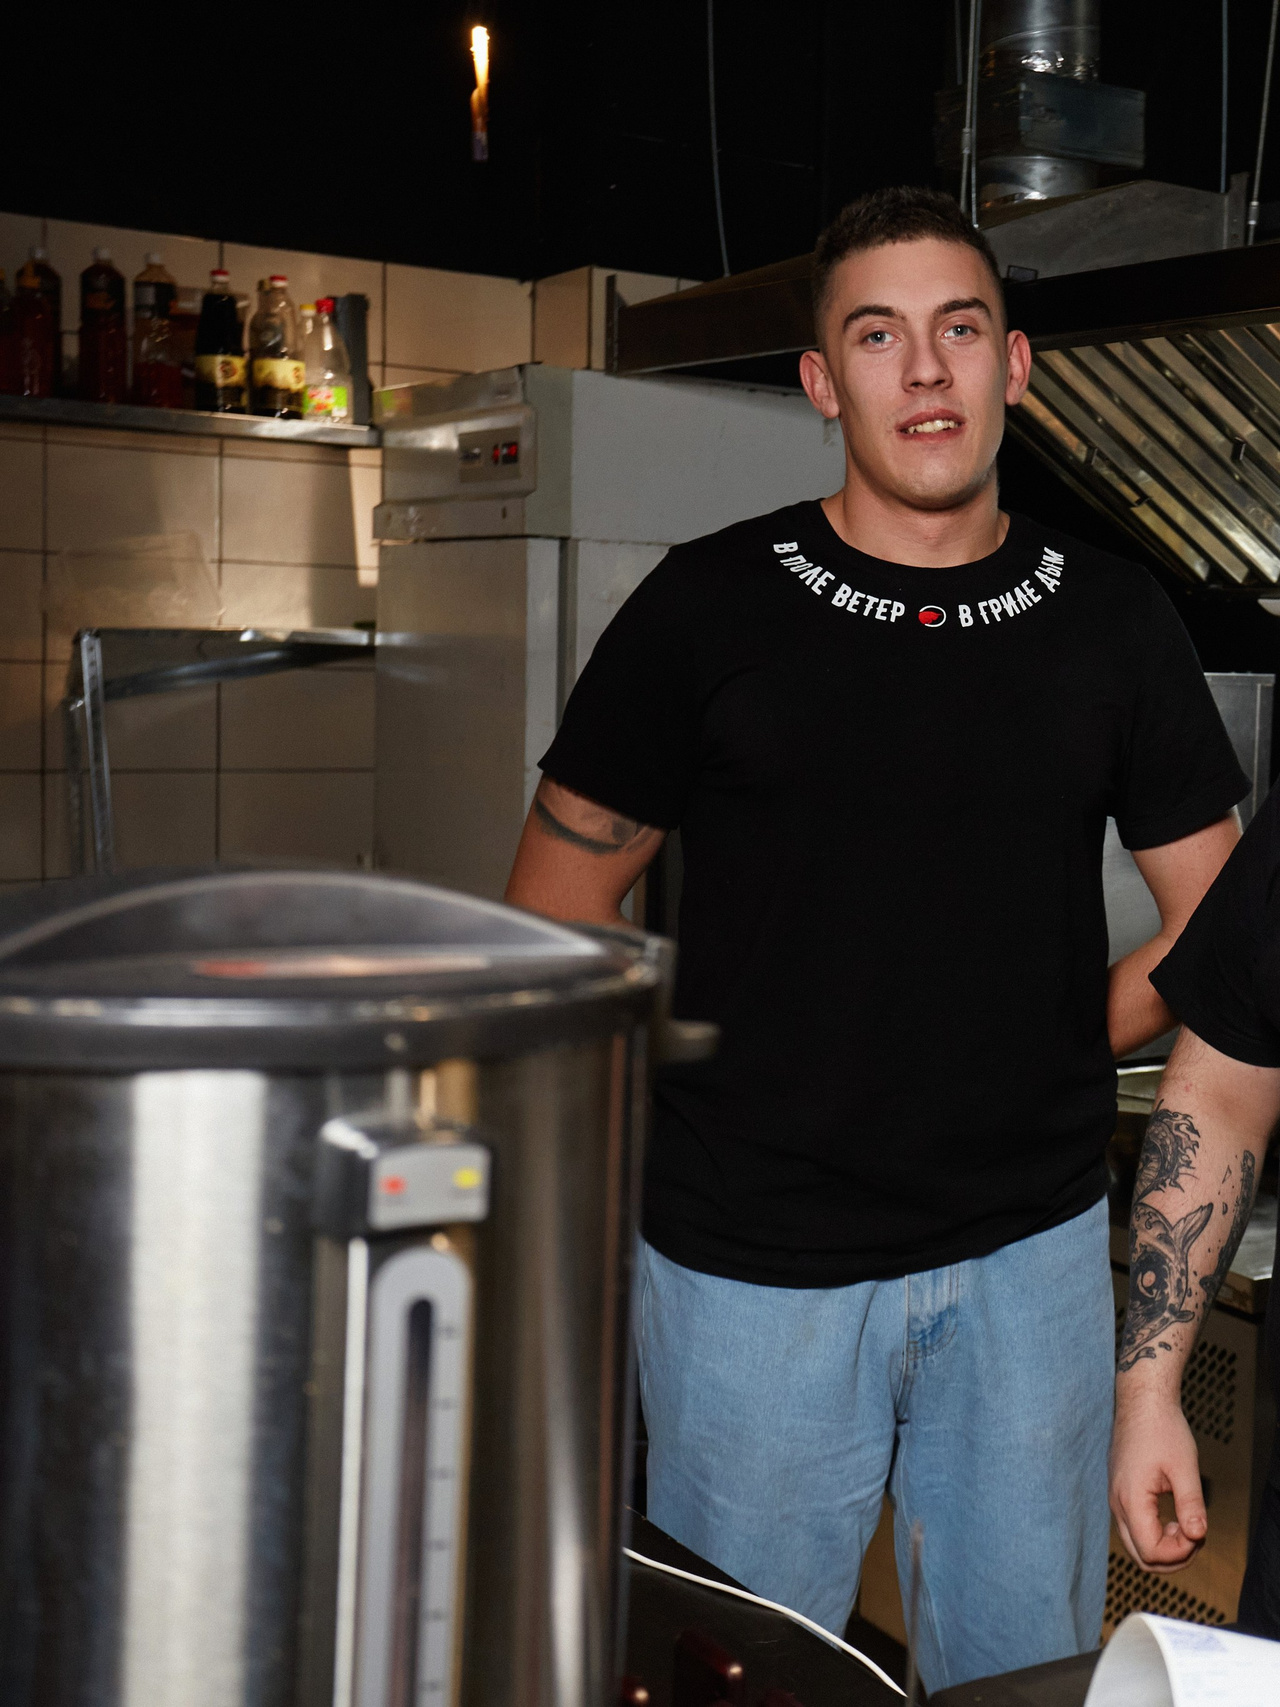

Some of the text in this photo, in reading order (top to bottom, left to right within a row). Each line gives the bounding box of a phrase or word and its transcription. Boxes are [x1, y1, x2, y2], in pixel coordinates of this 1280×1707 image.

[773, 541, 1065, 628] В ПОЛЕ ВЕТЕР В ГРИЛЕ ДЫМ
